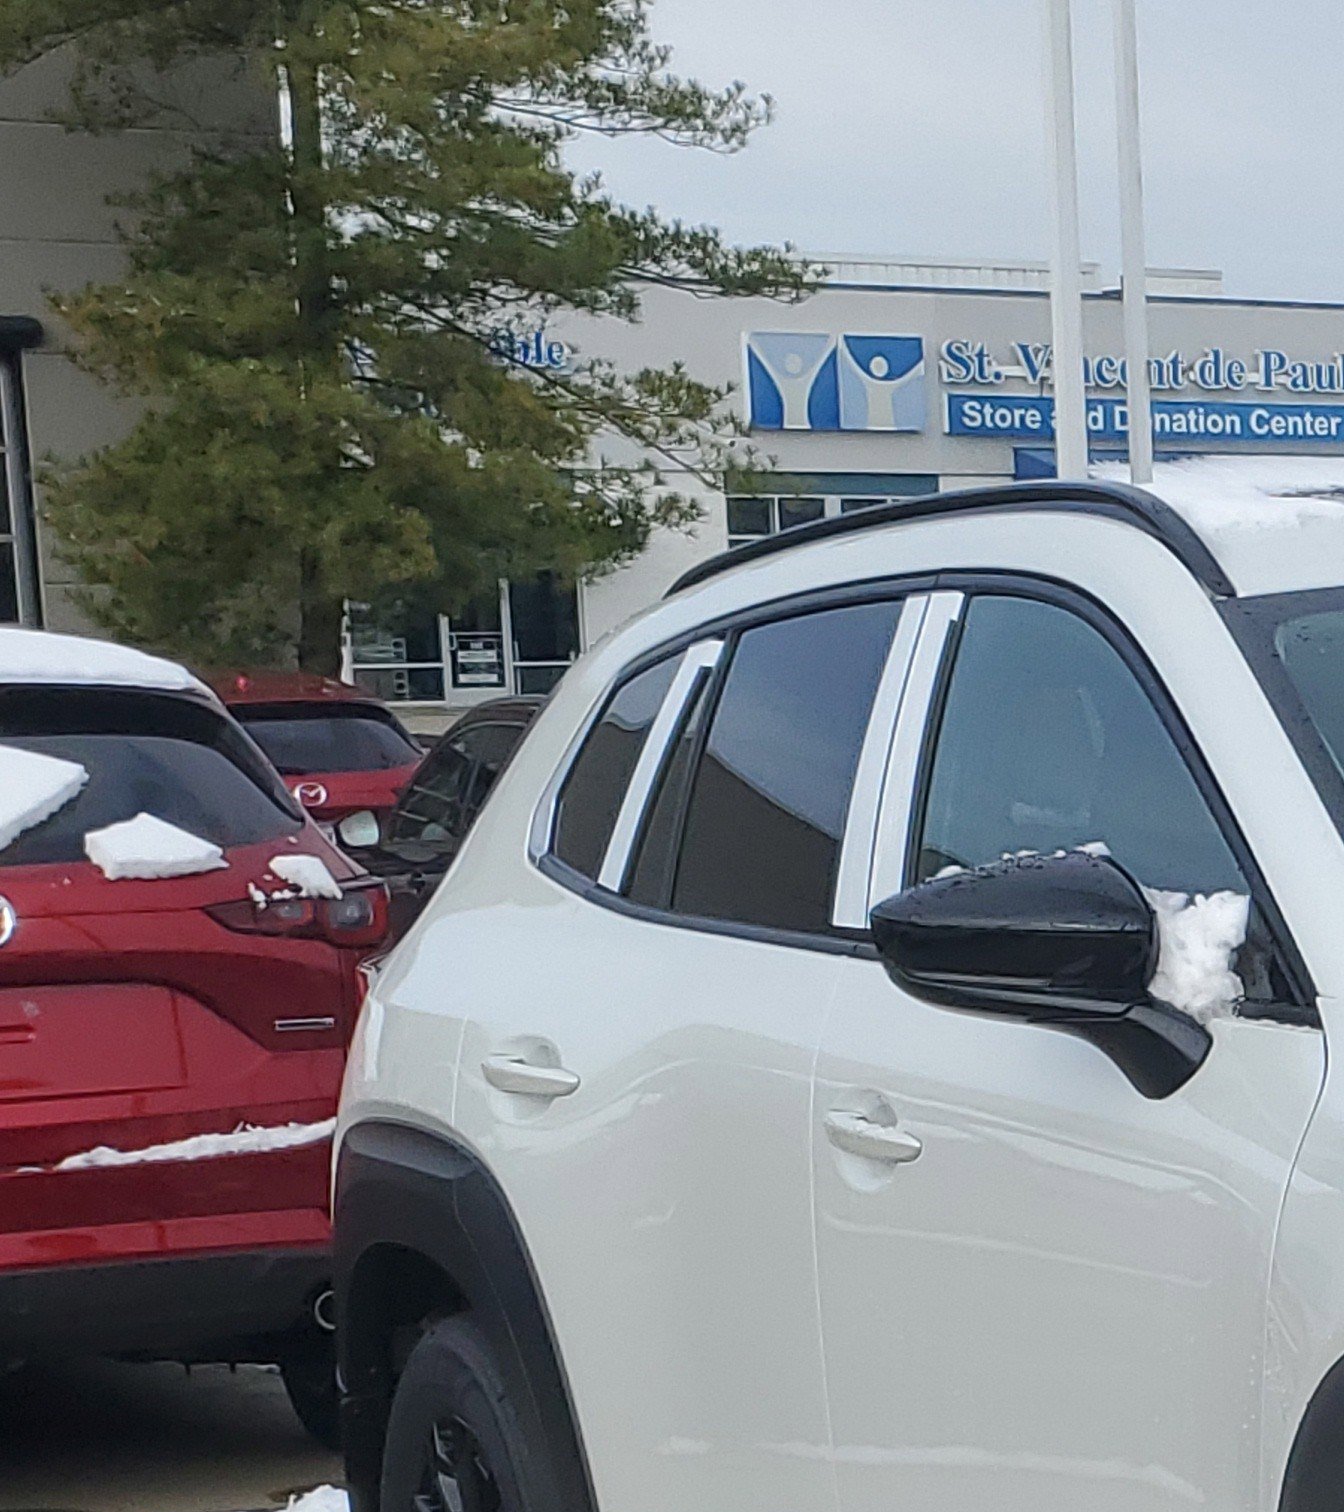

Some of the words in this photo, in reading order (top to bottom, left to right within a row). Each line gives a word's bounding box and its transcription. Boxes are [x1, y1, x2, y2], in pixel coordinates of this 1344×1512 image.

[939, 338, 1005, 383] St.
[1012, 342, 1187, 390] Vcnt
[1196, 347, 1247, 390] de
[961, 400, 1043, 431] Store
[1113, 405, 1241, 435] Dnation
[1250, 408, 1343, 436] Center
